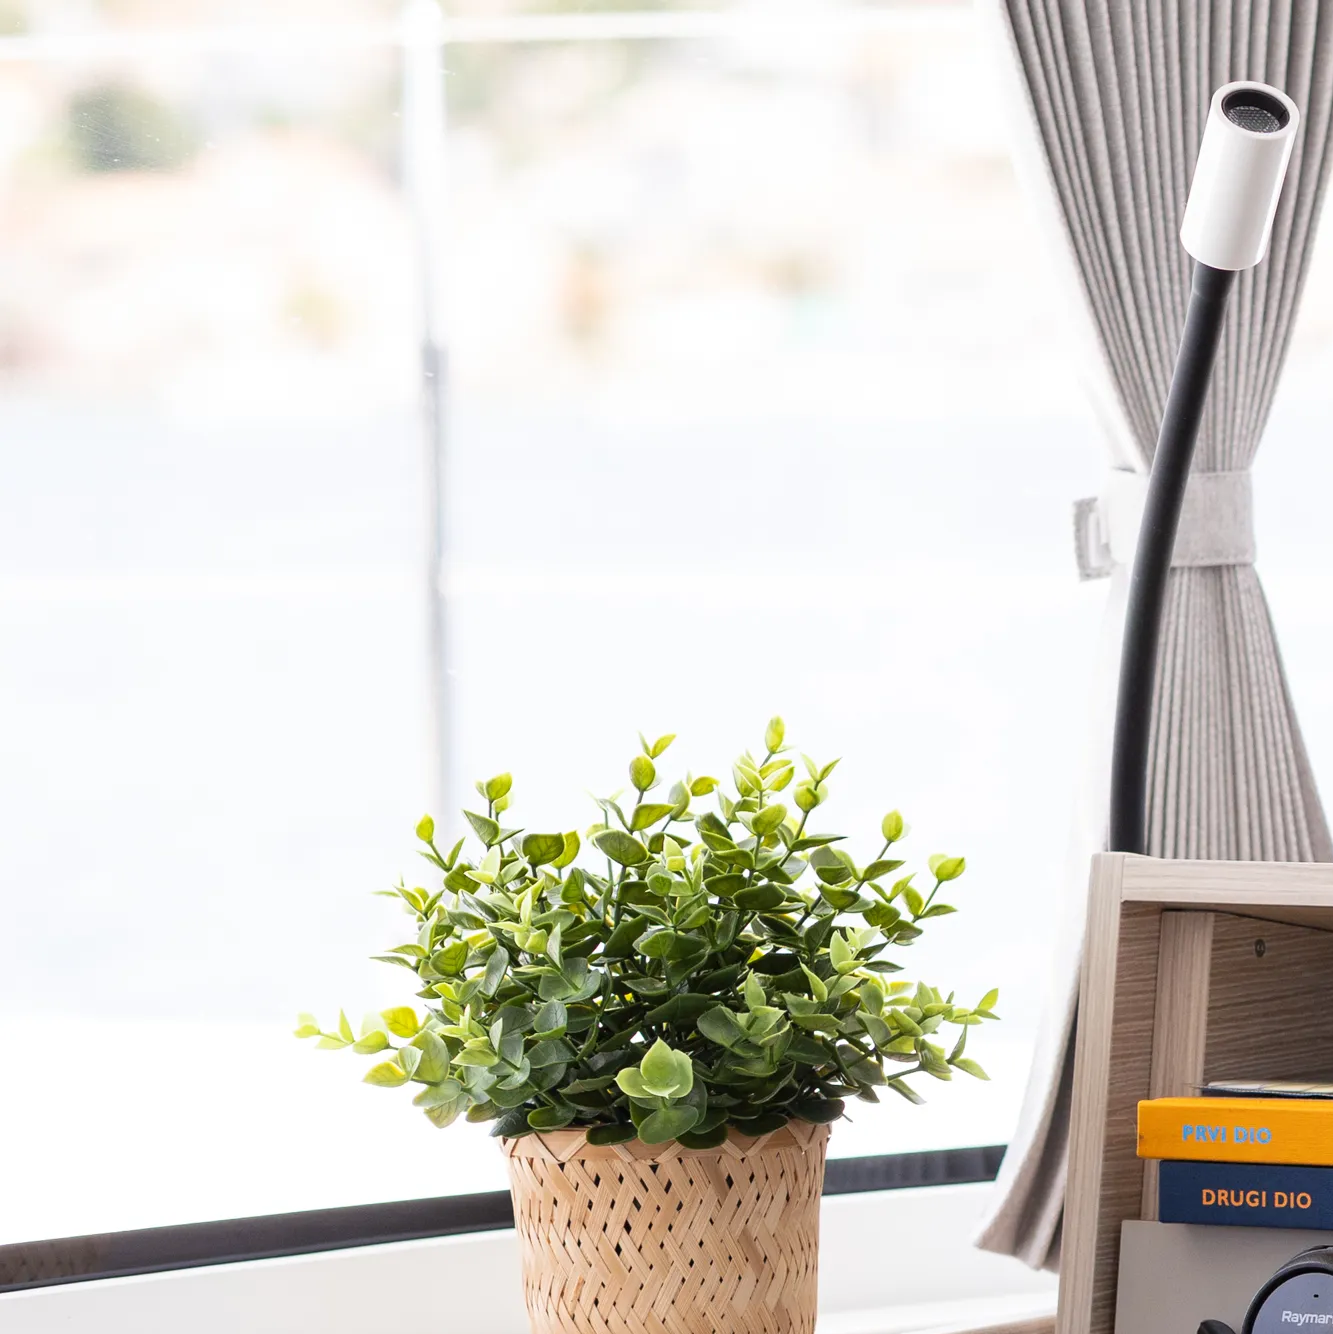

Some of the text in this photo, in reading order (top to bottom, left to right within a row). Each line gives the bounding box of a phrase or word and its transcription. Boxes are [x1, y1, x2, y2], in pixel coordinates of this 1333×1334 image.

[1182, 1125, 1226, 1143] PRVI
[1234, 1127, 1272, 1144] DIO
[1202, 1188, 1267, 1208] DRUGI
[1274, 1192, 1312, 1210] DIO
